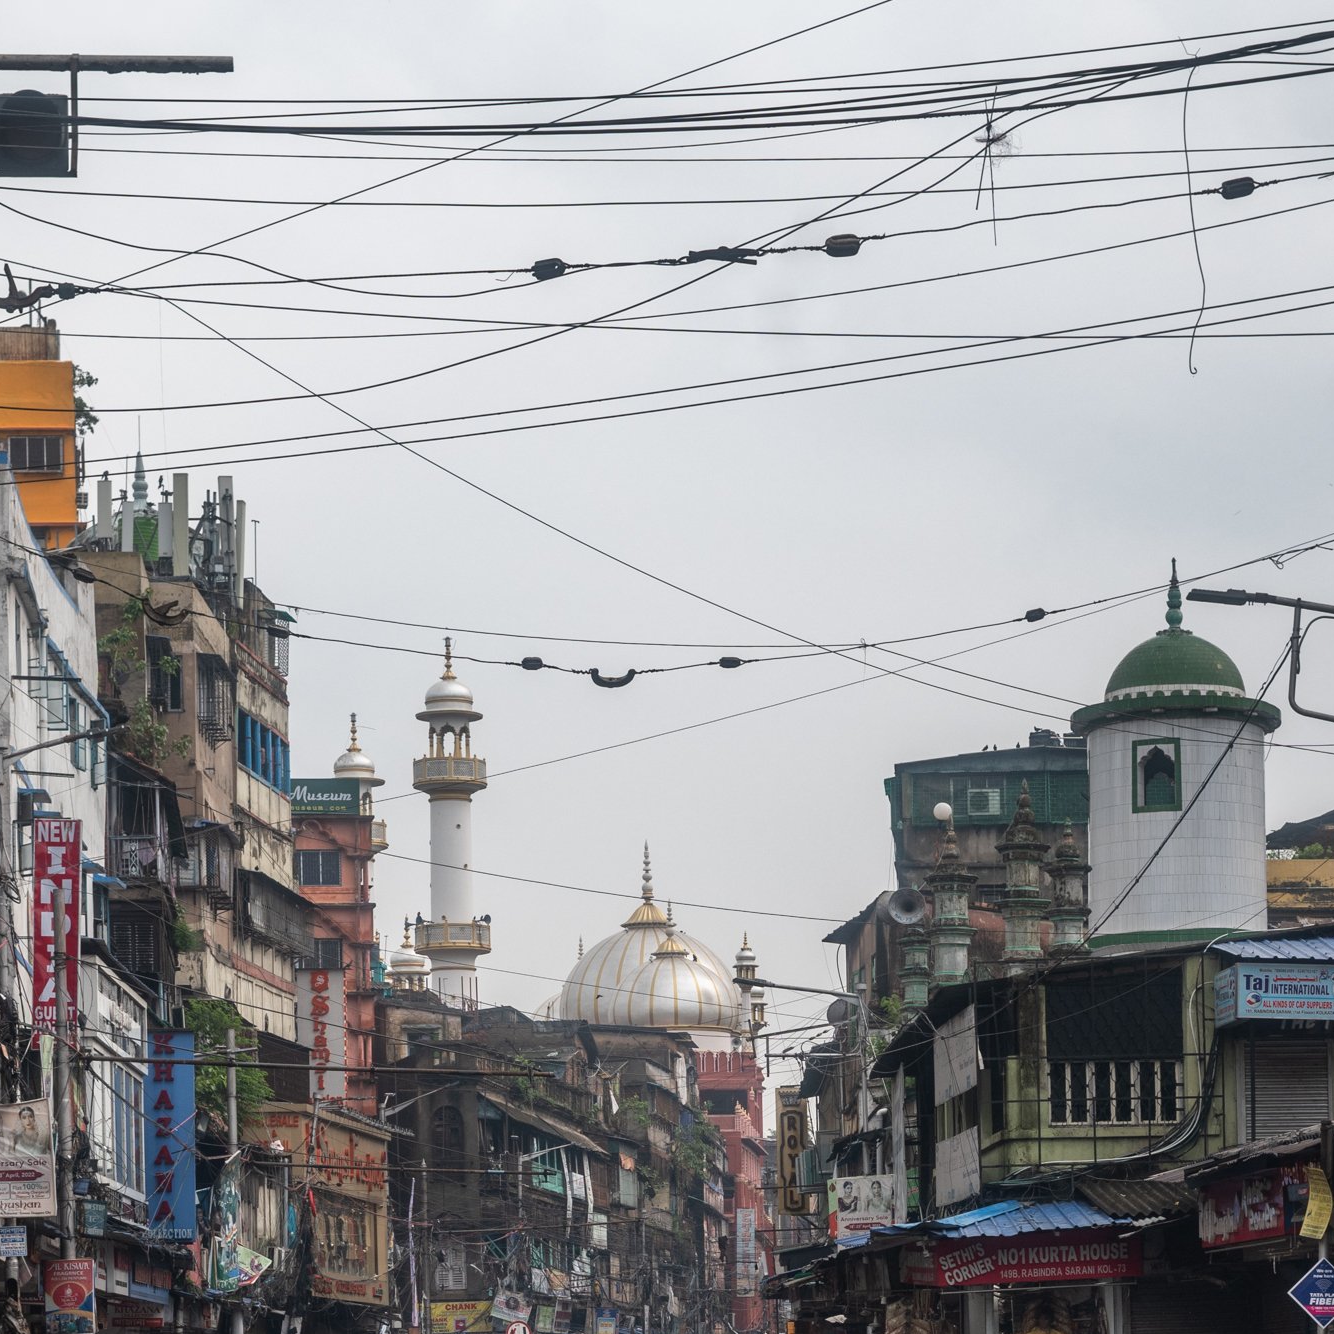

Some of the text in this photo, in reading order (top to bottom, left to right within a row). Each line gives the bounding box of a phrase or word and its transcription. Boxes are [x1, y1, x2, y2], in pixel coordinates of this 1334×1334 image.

[38, 821, 77, 844] NEW
[1243, 974, 1270, 993] Taj
[1271, 983, 1330, 996] INTERNATIONAL
[1263, 1000, 1333, 1009] ALL KINDS OF CAP SUPPLIERS
[28, 1158, 47, 1167] Sale
[938, 1243, 985, 1271] SETHI'S
[1028, 1242, 1129, 1264] KURTA HOUSE
[944, 1257, 994, 1286] CORNER
[1021, 1266, 1095, 1279] RABINDRA SARANI
[444, 1303, 478, 1311] CHANK
